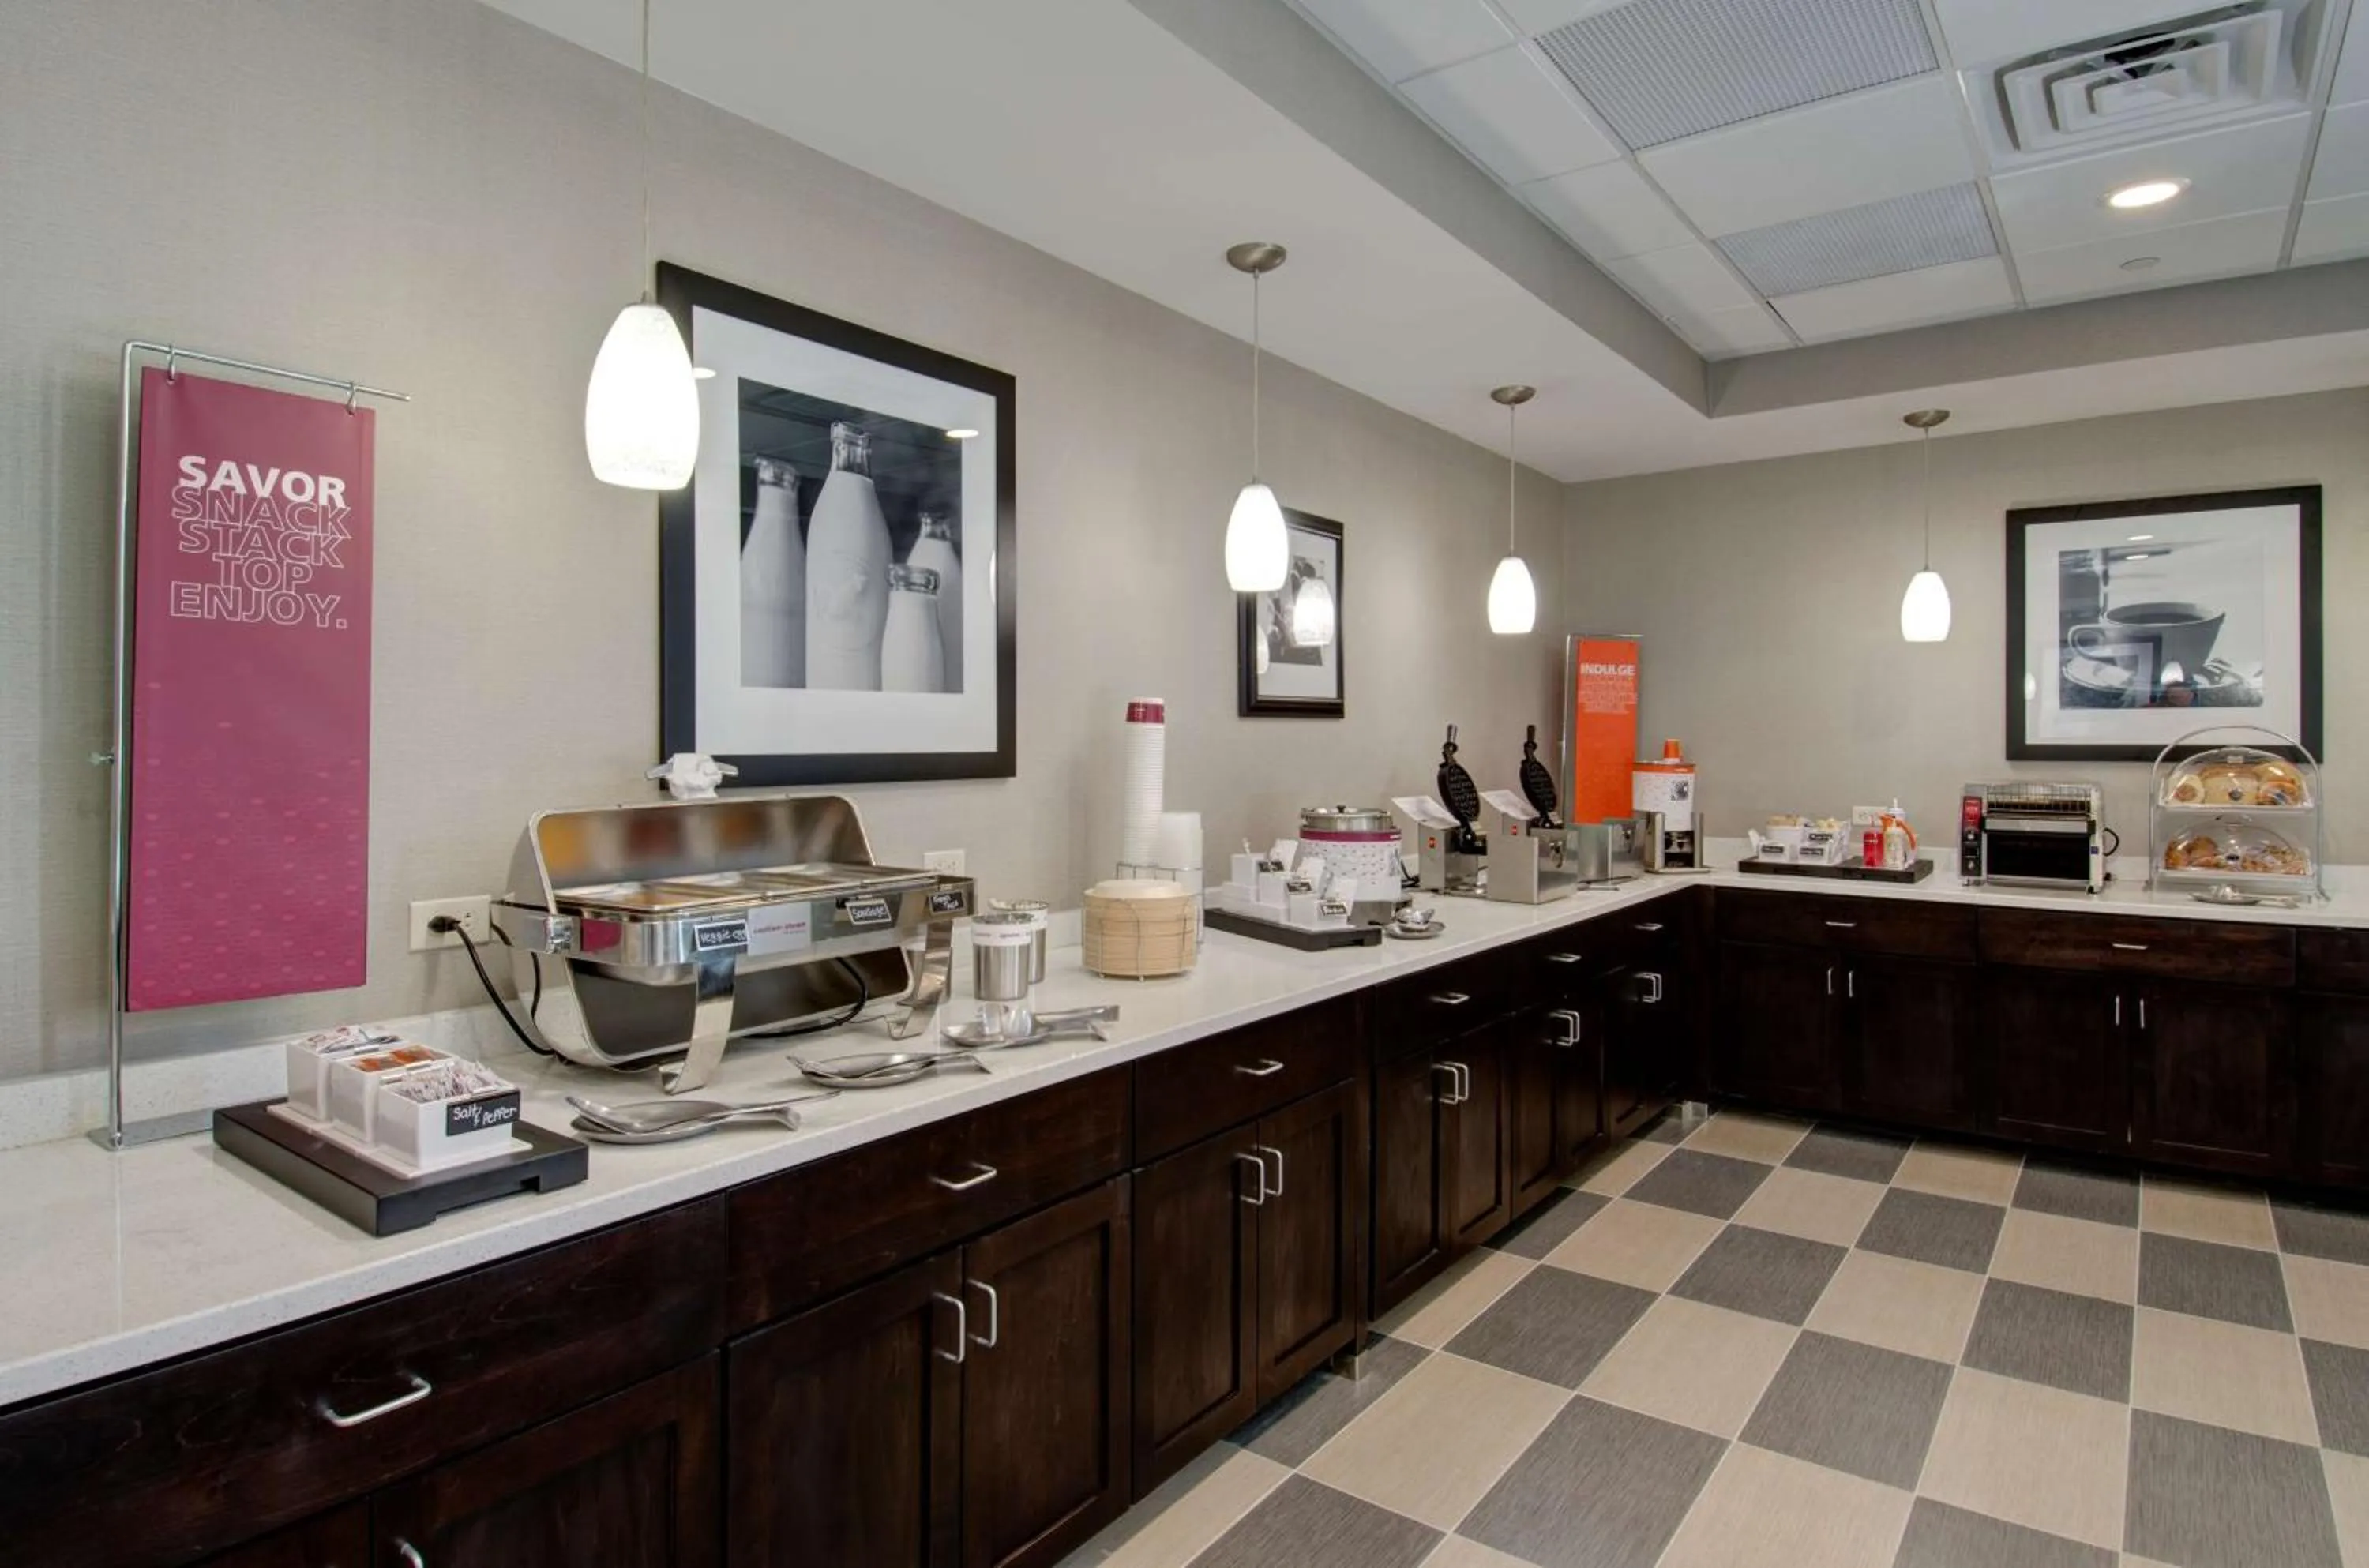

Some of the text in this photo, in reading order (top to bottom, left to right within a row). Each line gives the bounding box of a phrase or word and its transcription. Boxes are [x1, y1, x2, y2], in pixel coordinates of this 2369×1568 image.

[178, 455, 347, 509] SAVOR
[171, 483, 352, 539] SNACK
[178, 518, 344, 568] STACK
[212, 553, 314, 594] TOP
[170, 580, 348, 629] ENJOY.
[1580, 663, 1636, 676] INDULGE
